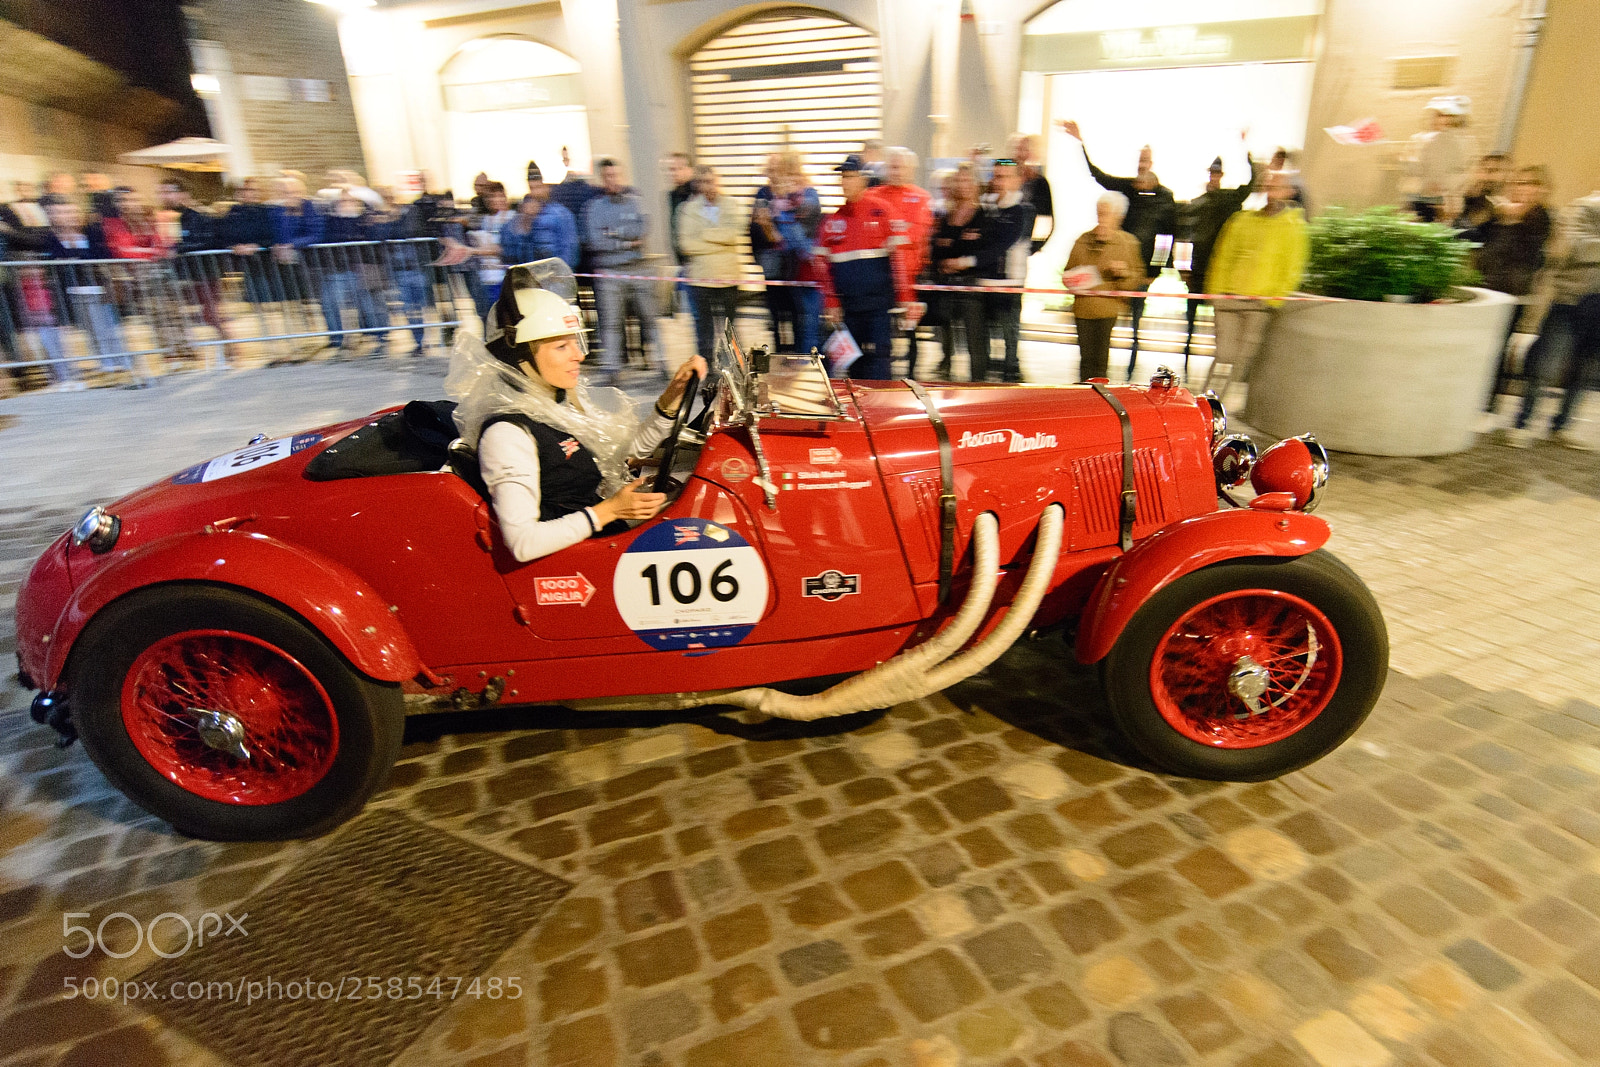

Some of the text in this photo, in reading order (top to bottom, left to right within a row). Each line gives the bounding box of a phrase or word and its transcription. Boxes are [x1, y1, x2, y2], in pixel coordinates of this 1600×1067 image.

[957, 428, 1058, 453] Aston Martin
[540, 579, 579, 590] 1000
[640, 558, 739, 606] 106
[539, 591, 583, 602] MIGLIA
